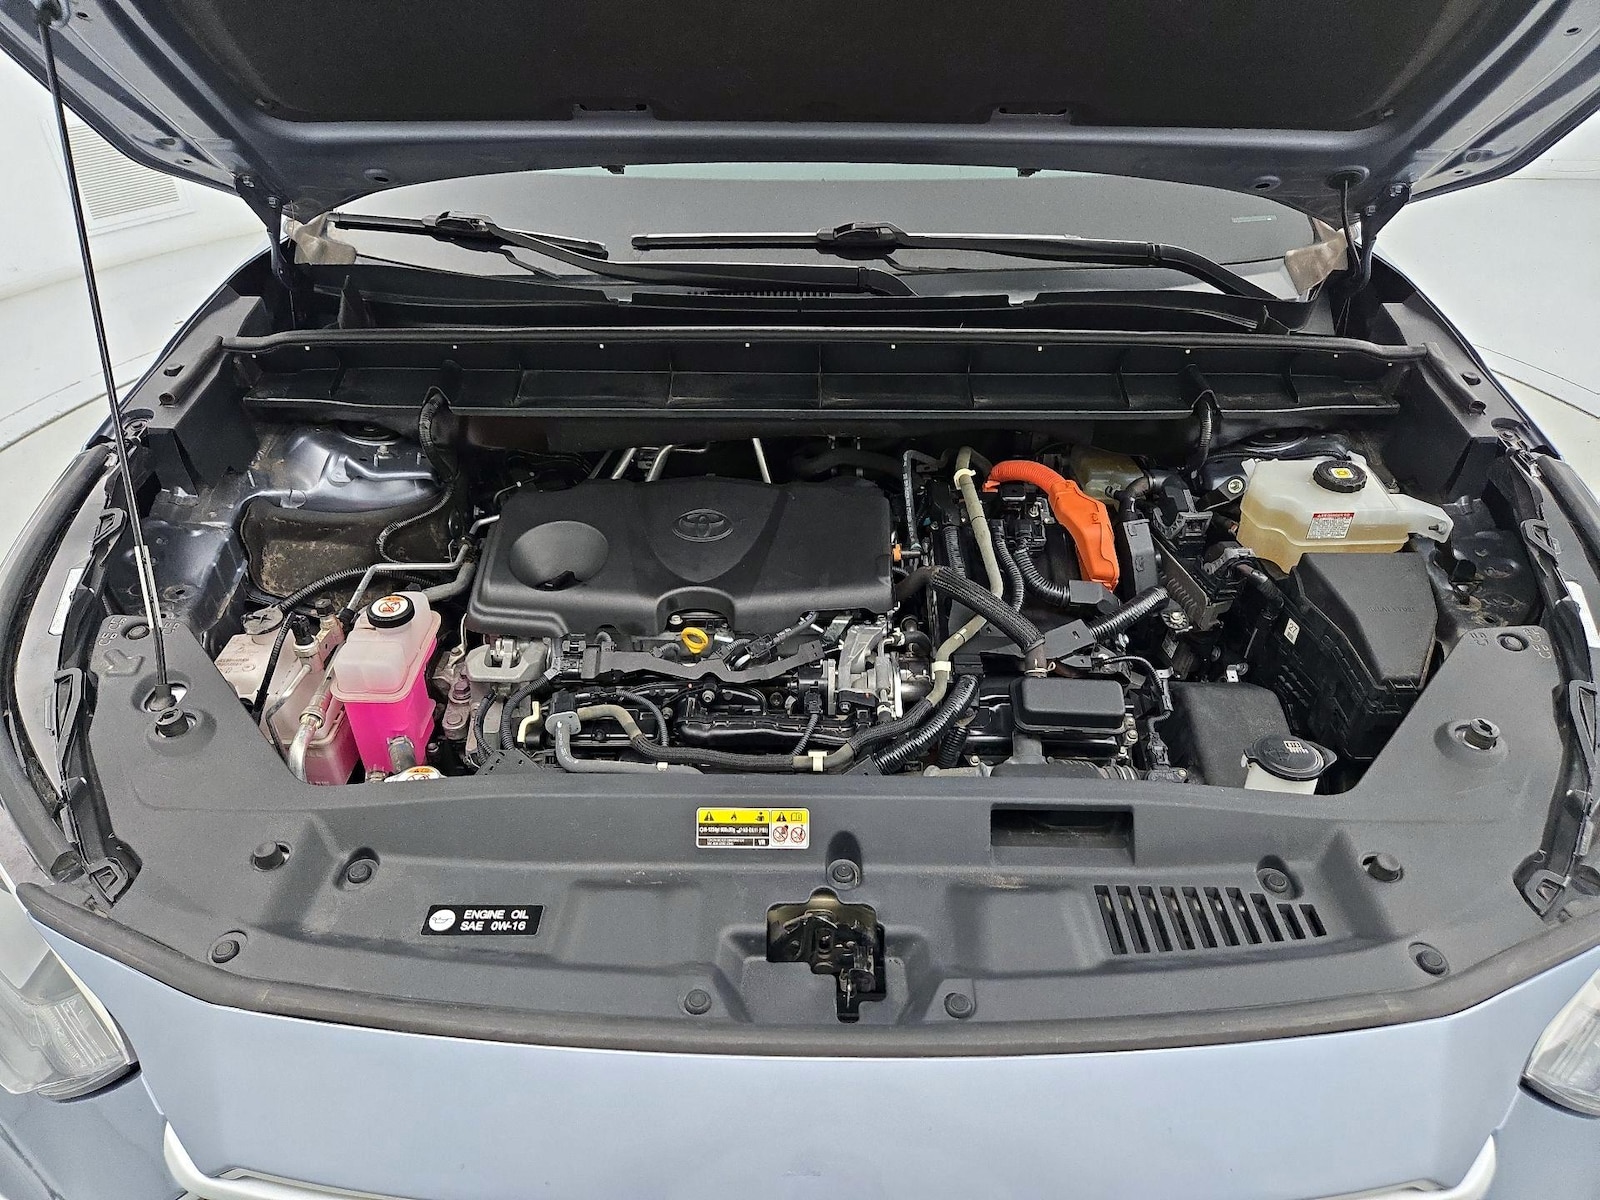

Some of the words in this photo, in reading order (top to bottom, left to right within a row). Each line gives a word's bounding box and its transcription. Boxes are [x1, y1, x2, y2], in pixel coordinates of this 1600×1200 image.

[1288, 622, 1298, 633] 27
[463, 909, 505, 919] ENGINE
[511, 909, 529, 919] OIL
[460, 921, 485, 931] SAE
[490, 921, 527, 931] 0W-16
